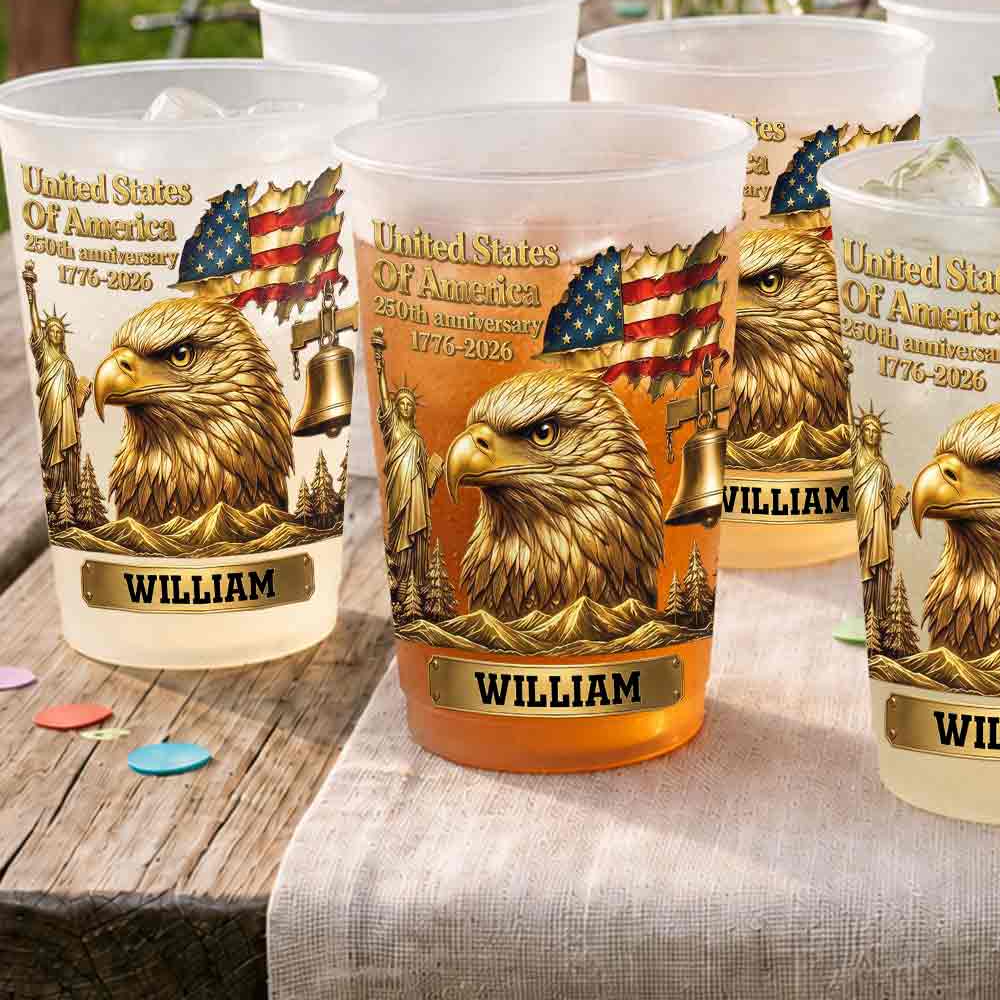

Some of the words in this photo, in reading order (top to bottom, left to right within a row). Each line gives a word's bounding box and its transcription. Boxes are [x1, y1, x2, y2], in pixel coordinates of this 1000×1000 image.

[20, 164, 109, 203] United
[112, 173, 192, 205] States
[22, 199, 61, 233] Of
[65, 207, 177, 241] America
[24, 233, 75, 259] 250th
[79, 247, 179, 269] anniversary
[371, 219, 468, 264] United
[473, 232, 560, 268] States
[57, 263, 153, 291] 1776-2026
[842, 238, 940, 288] United
[372, 258, 415, 296] Of
[418, 265, 542, 308] America
[841, 278, 885, 318] Of
[373, 295, 428, 325] 250th
[432, 312, 546, 338] anniversary
[841, 317, 898, 350] 250th
[410, 329, 514, 361] 1776-2026
[878, 355, 987, 391] 1776-2026
[123, 569, 276, 604] WILLIAM
[474, 671, 641, 707] WILLIAM
